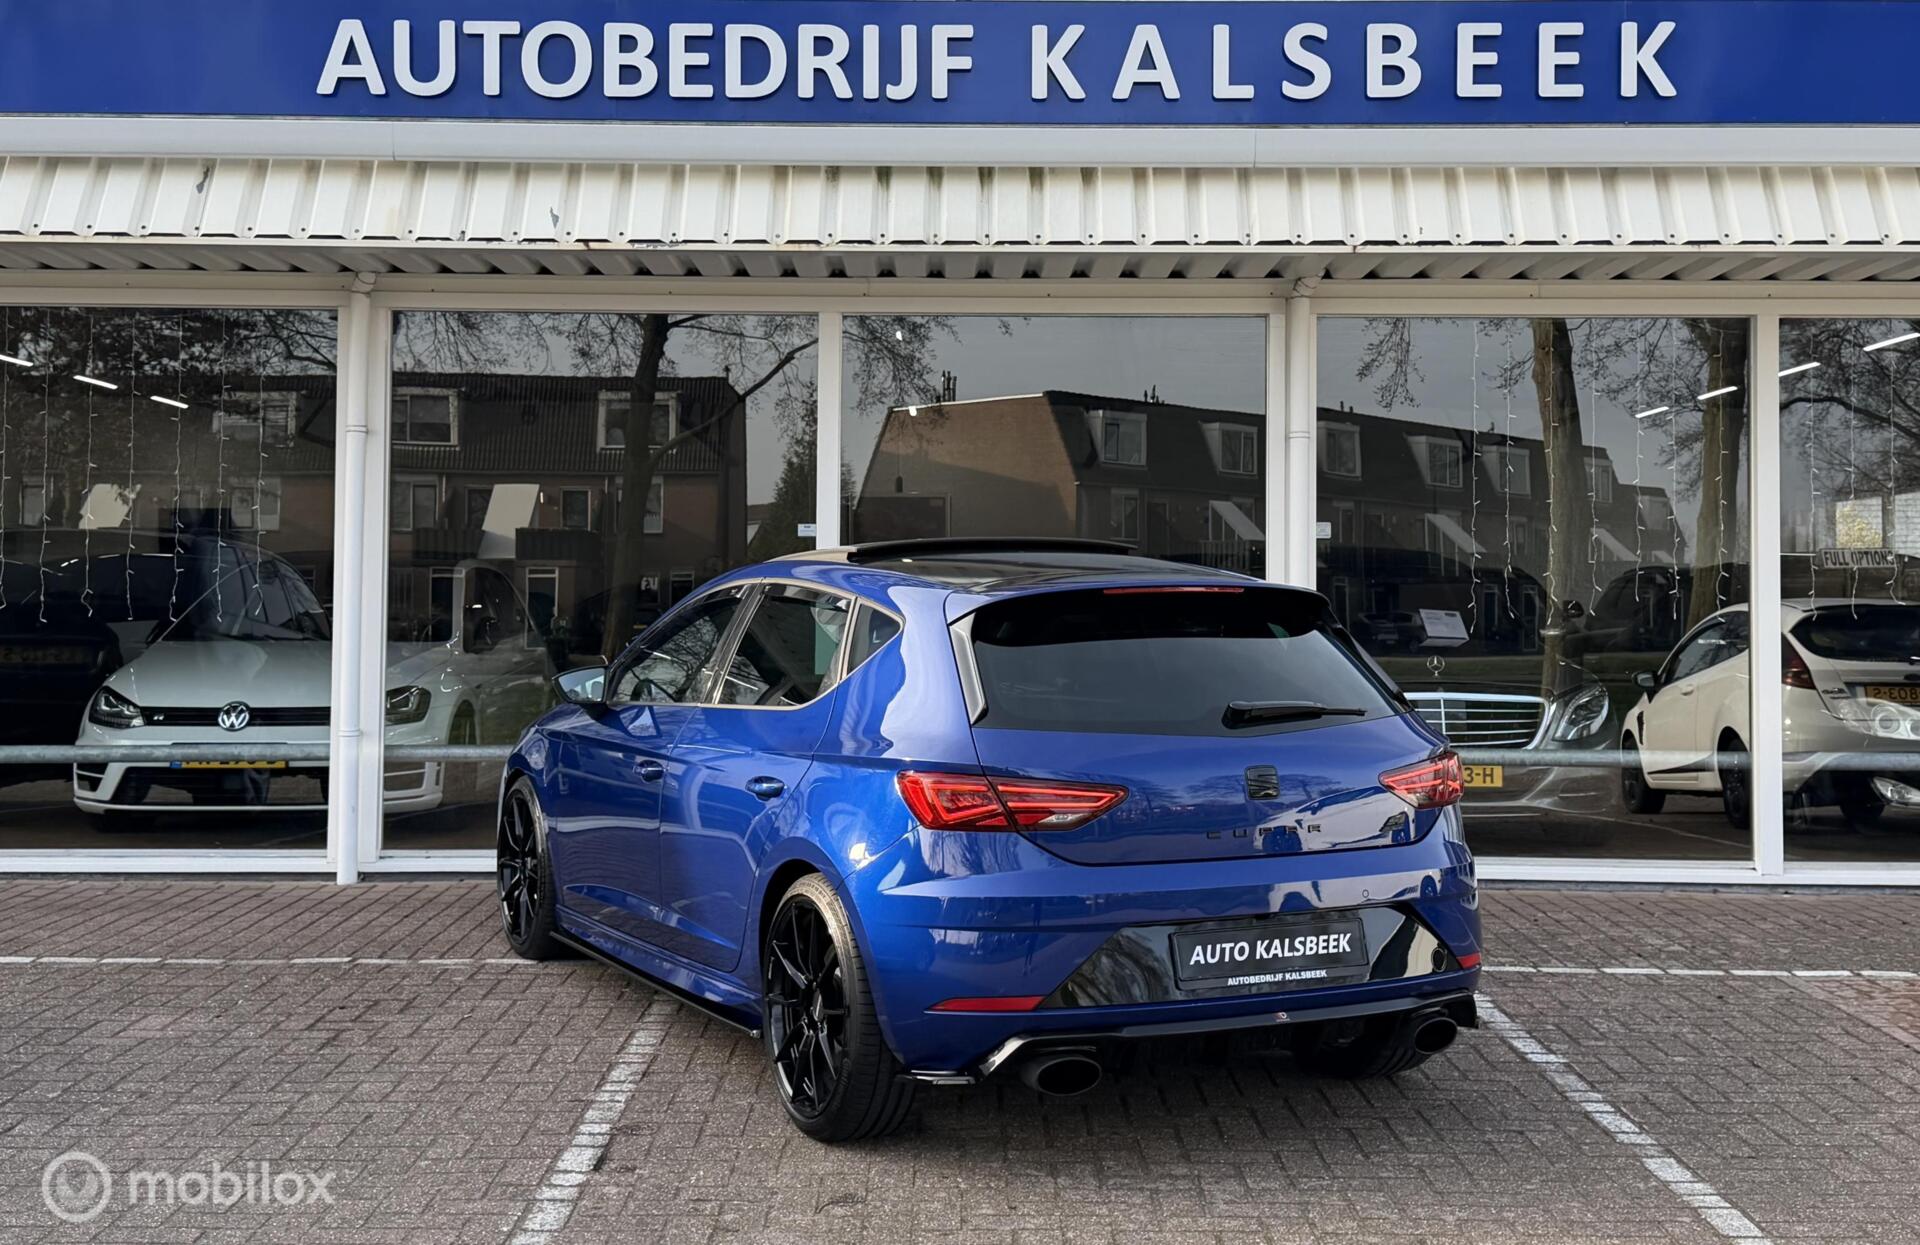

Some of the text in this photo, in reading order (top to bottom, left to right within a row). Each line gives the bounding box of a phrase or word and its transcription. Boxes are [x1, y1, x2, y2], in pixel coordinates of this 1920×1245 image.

[317, 19, 1677, 100] AUTOBEDRIJF KALSBEEK
[1824, 551, 1849, 566] FULL
[1464, 767, 1495, 784] 3-H
[1189, 933, 1351, 965] AUTO KALSBEEK
[1227, 969, 1328, 986] AUTOBEDRIJF KALSBEEK
